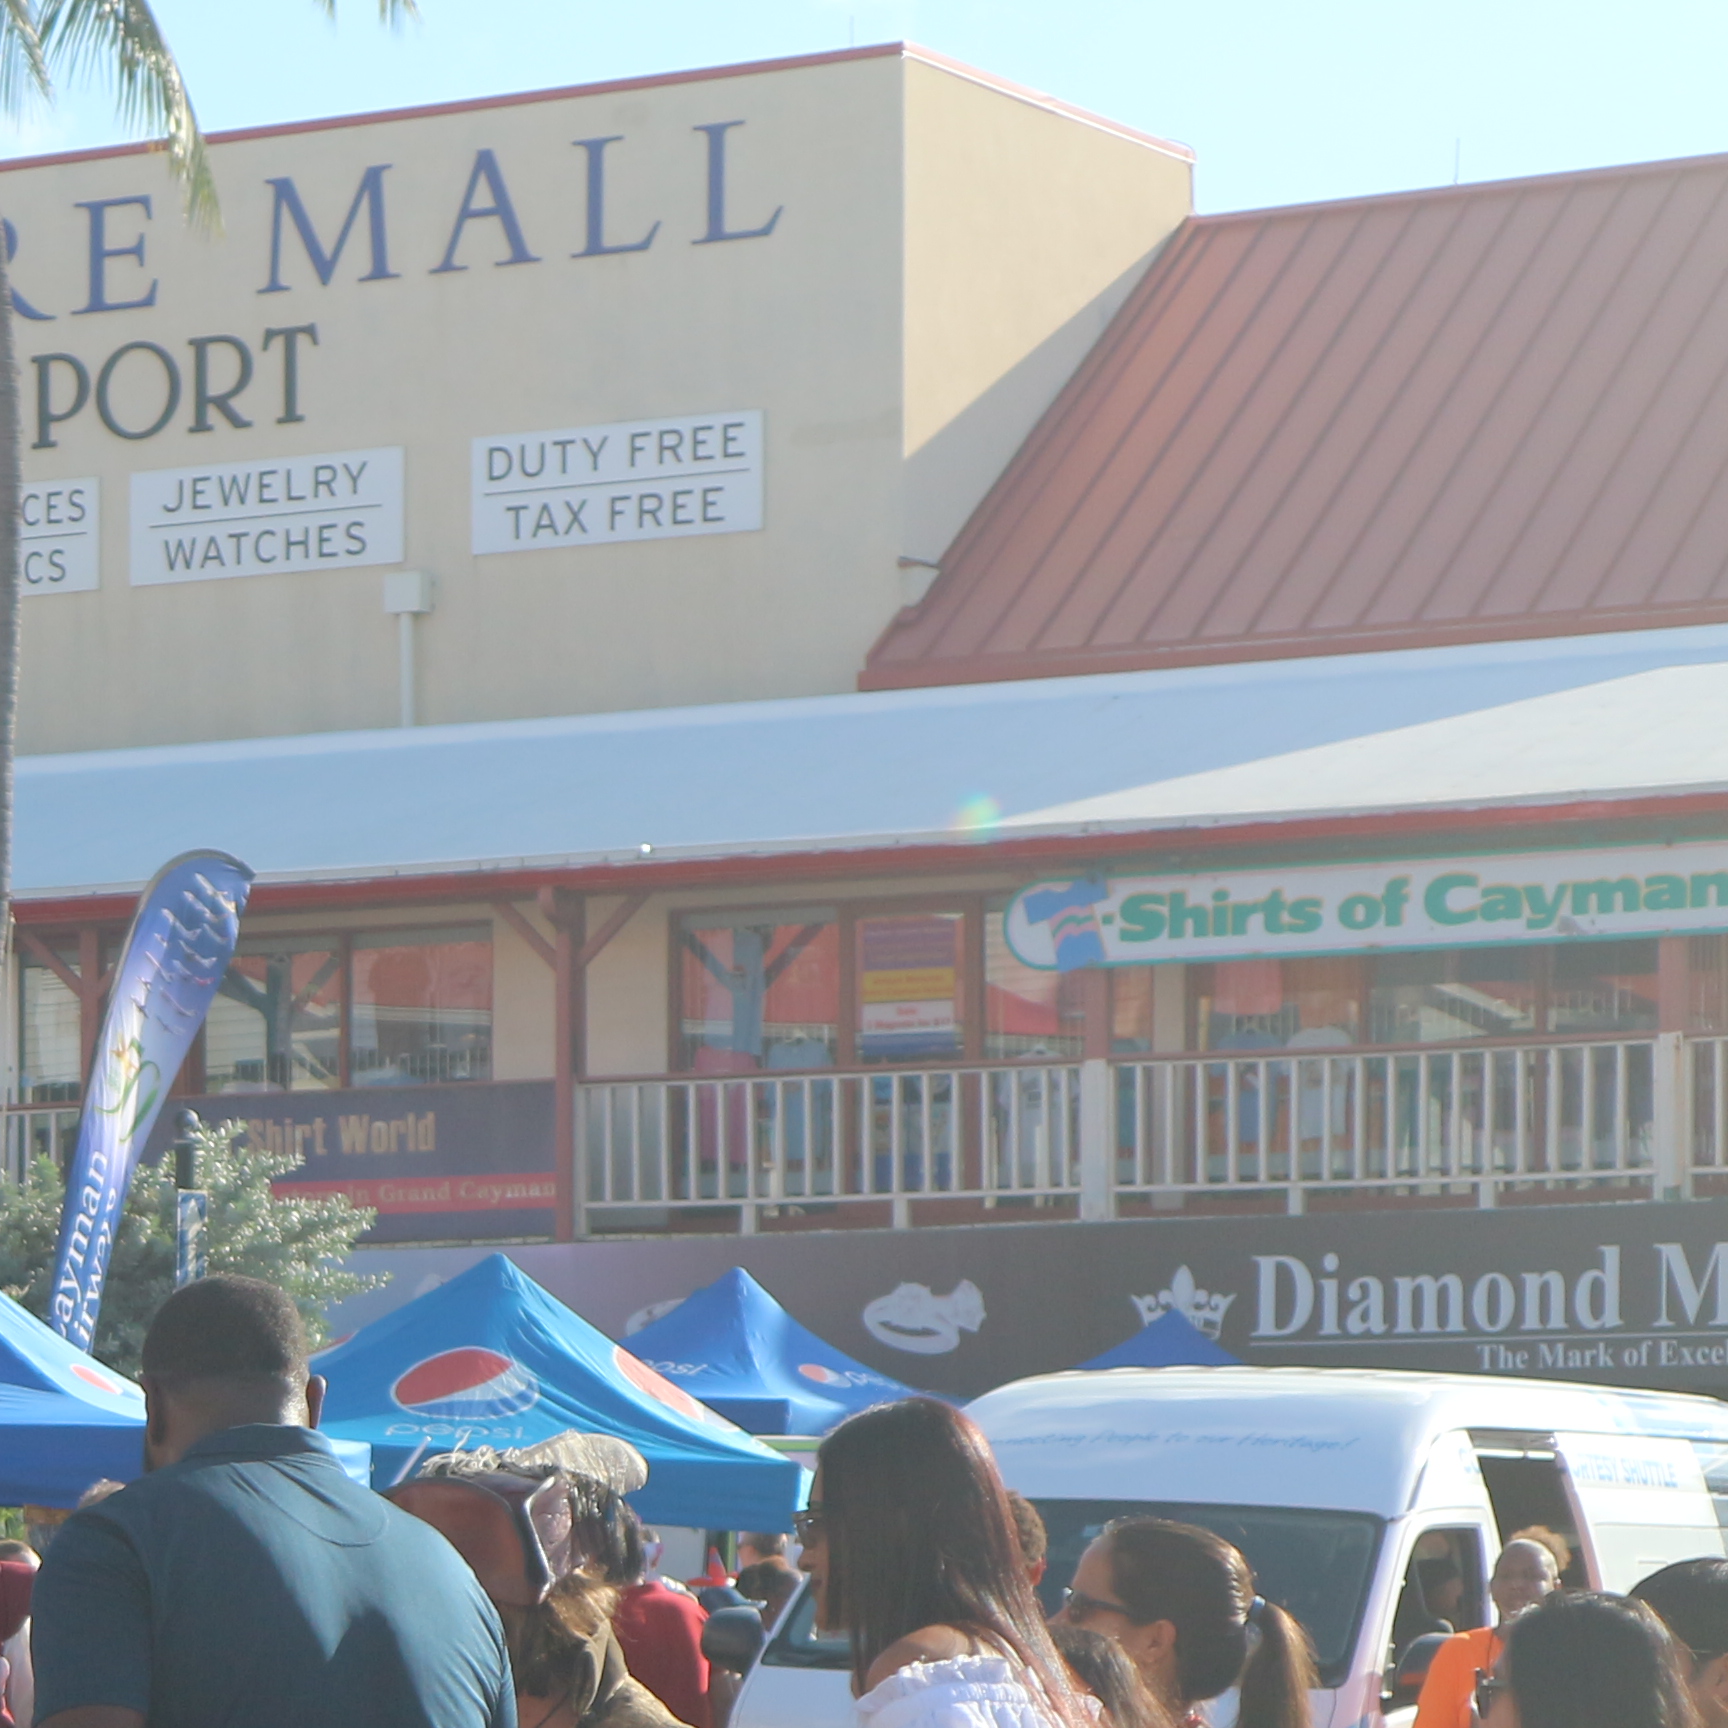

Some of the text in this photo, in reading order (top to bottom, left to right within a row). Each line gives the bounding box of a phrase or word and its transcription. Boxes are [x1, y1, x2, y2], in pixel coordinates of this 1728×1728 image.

[256, 119, 784, 295] MALL
[486, 421, 747, 482] DUTY FREE
[162, 460, 368, 514] JEWELRY
[505, 486, 726, 541] TAX FREE
[163, 521, 367, 573] WATCHES
[1337, 877, 1413, 929] of
[1423, 870, 1728, 933] Cayman
[338, 1111, 436, 1155] World
[378, 1178, 452, 1203] Grand
[459, 1178, 557, 1206] Cayman
[1251, 1243, 1625, 1338] Diamond
[1476, 1343, 1529, 1371] The
[1539, 1340, 1614, 1369] Mark
[1623, 1339, 1653, 1367] of
